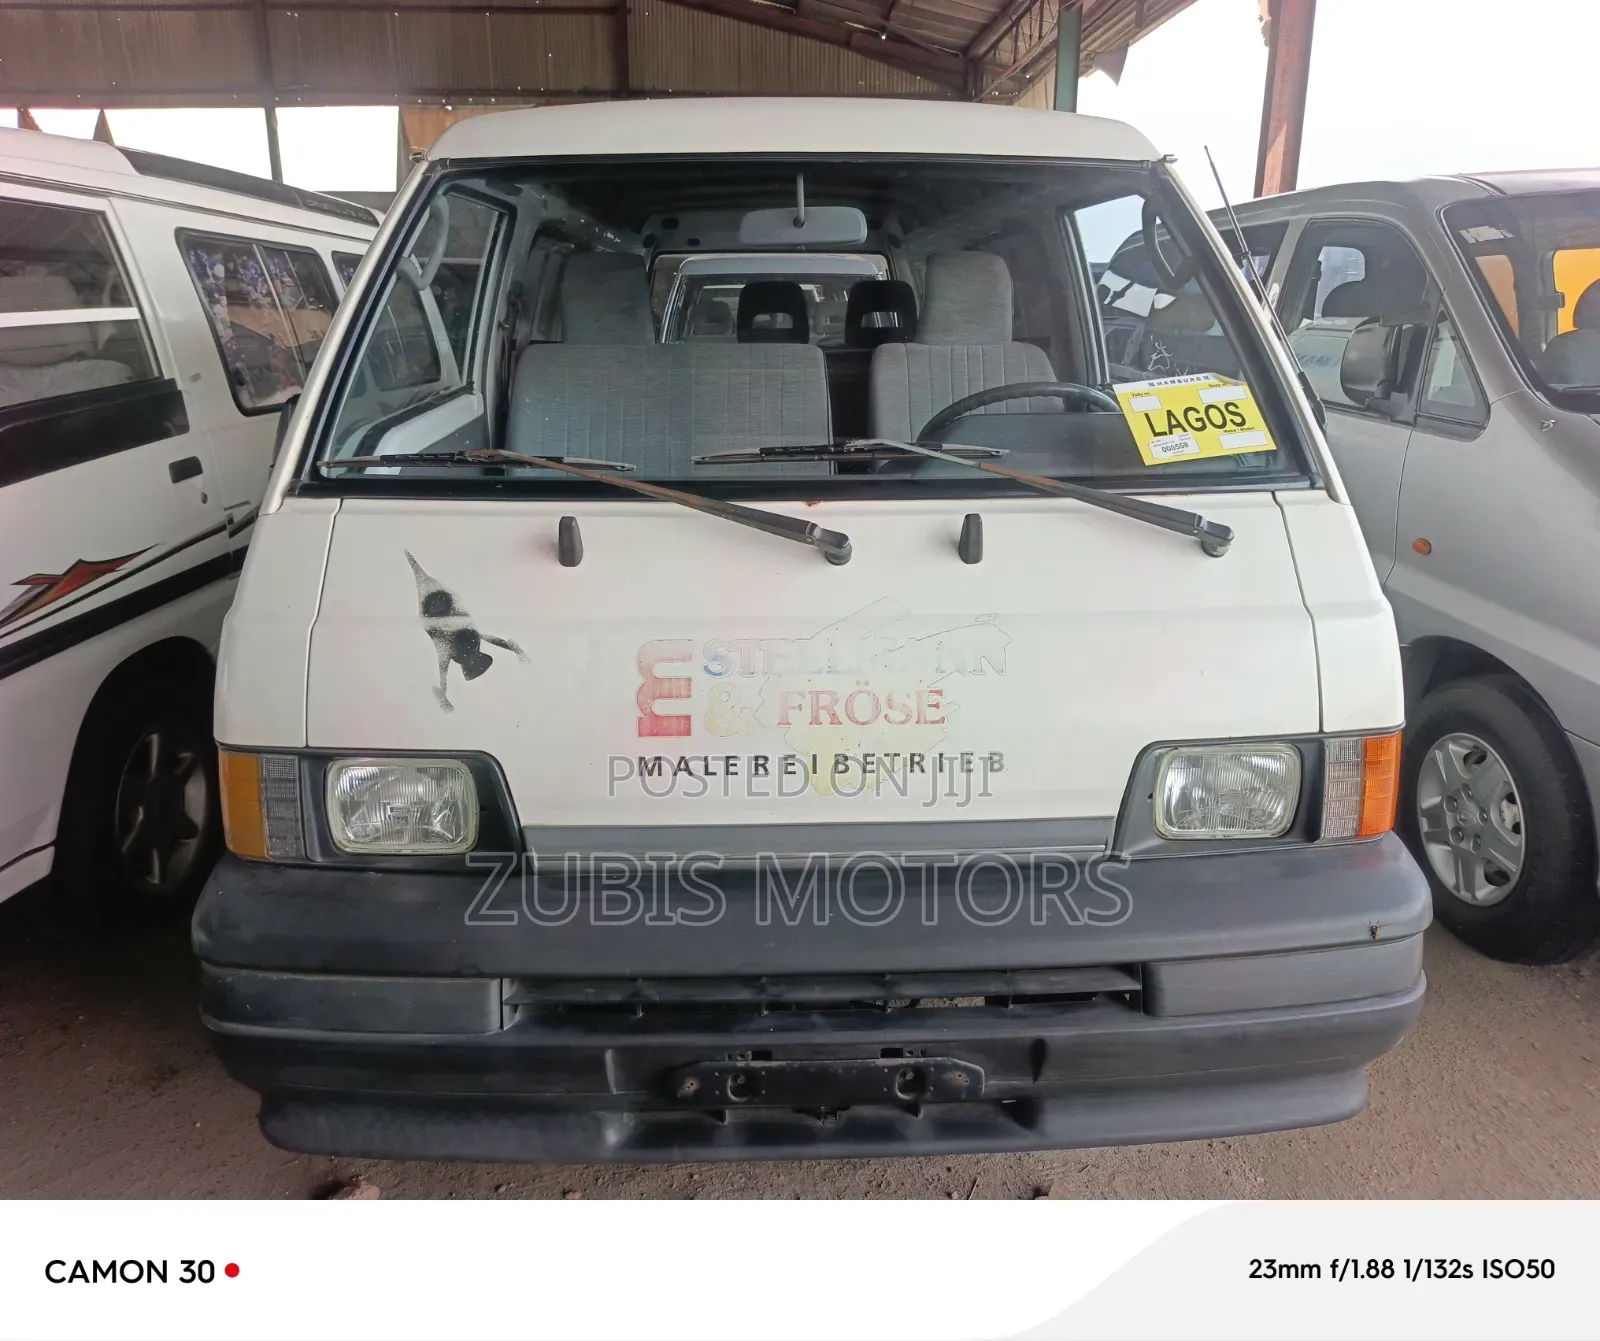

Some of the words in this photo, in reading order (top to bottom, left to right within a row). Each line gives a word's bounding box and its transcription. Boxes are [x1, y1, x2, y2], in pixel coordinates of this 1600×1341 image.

[1156, 376, 1202, 387] HAMBURG
[1144, 402, 1247, 437] LAGOS
[1161, 441, 1189, 453] 000558
[776, 680, 948, 726] FRÖSE
